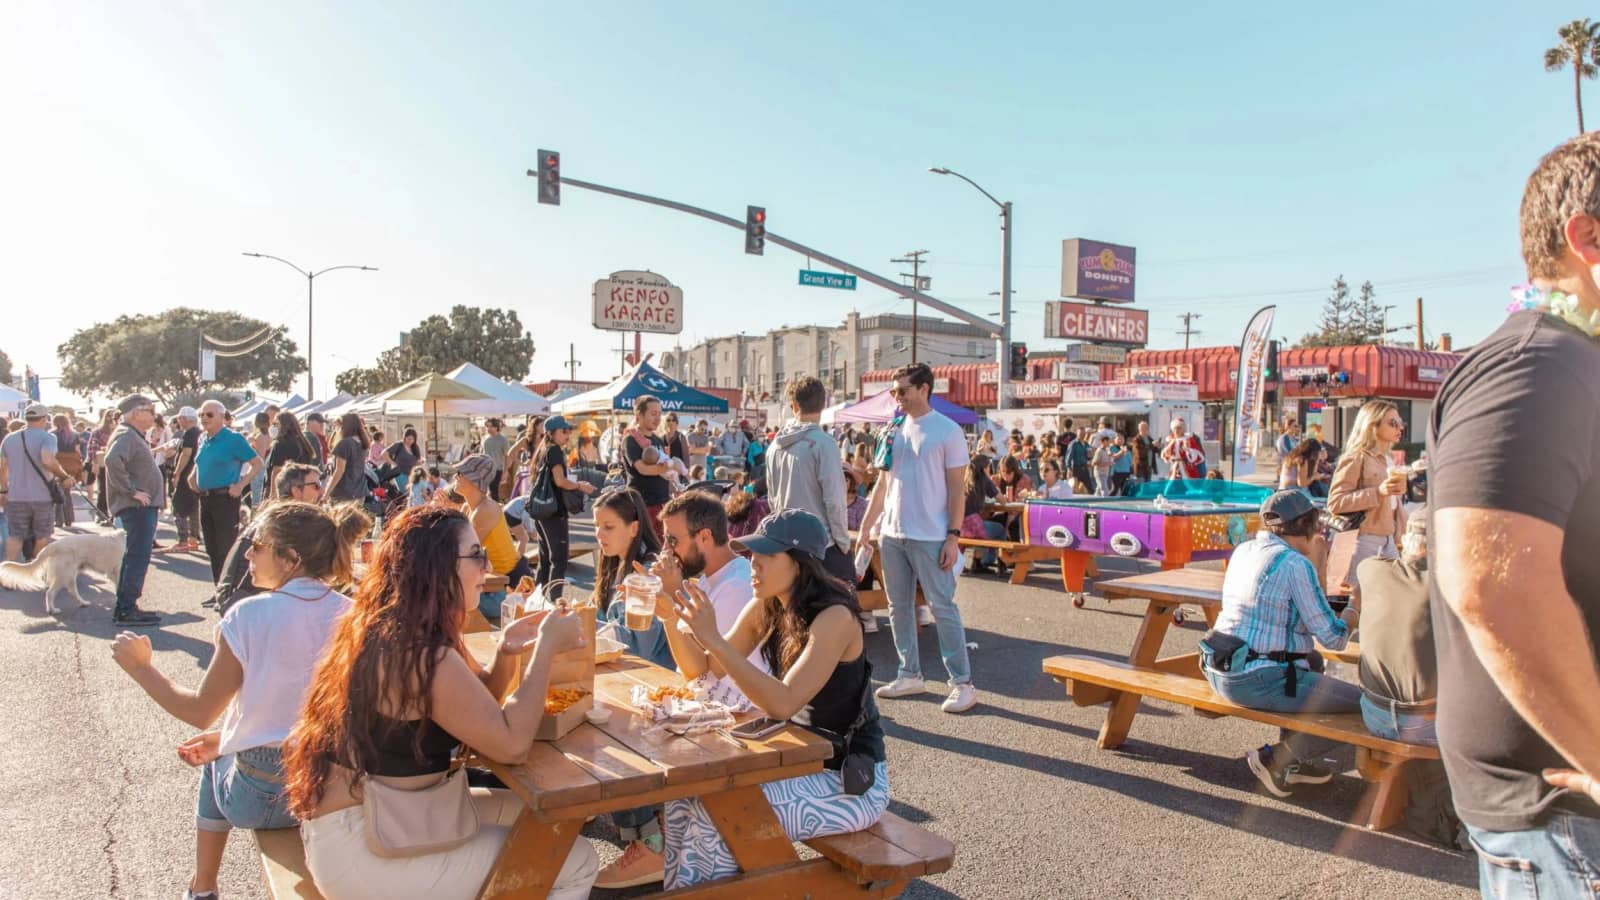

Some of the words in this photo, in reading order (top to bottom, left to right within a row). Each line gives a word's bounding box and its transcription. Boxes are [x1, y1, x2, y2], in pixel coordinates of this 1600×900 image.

[803, 273, 825, 284] Grand
[827, 276, 843, 286] View
[1085, 271, 1130, 284] DONUTS
[610, 287, 669, 306] KENPO
[604, 303, 675, 324] KARATE
[1063, 312, 1145, 341] CLEANERS
[621, 397, 684, 410] HIWAY
